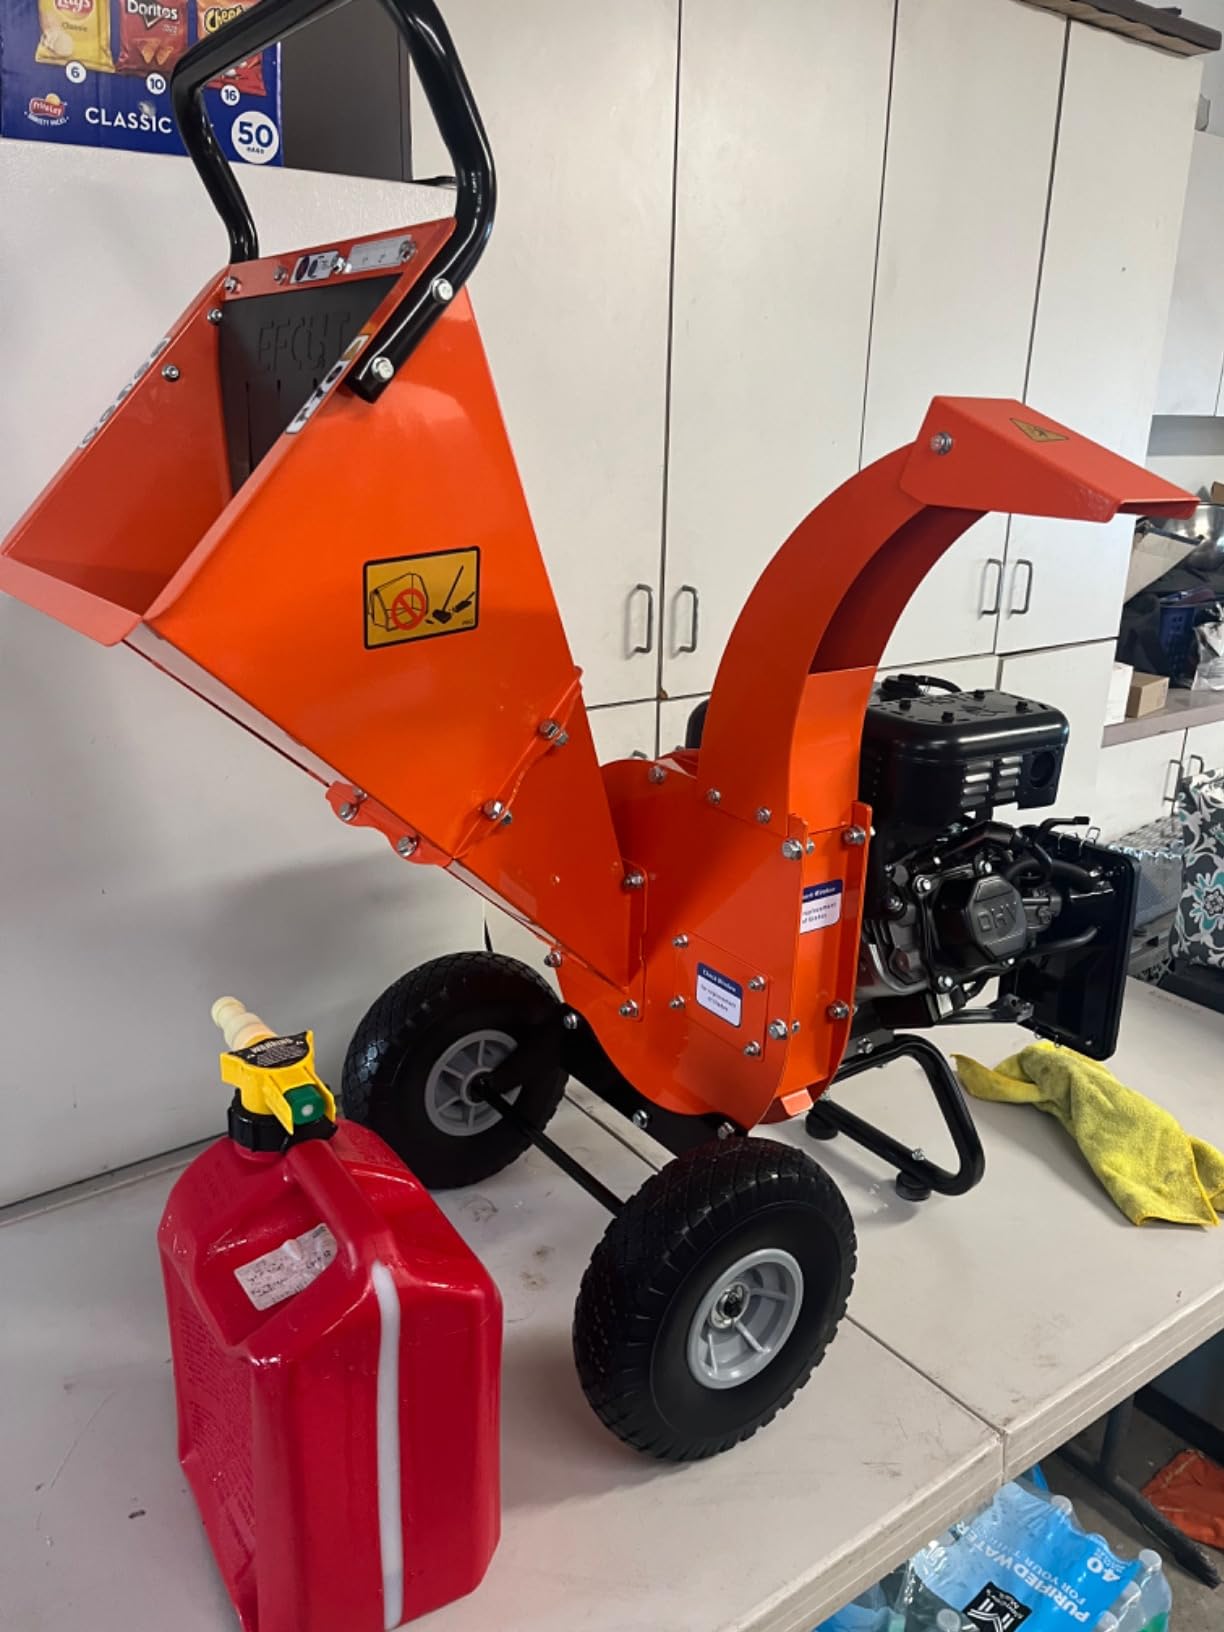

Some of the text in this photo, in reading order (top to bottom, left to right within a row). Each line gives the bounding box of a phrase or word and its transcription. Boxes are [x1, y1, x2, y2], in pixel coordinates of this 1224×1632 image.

[127, 0, 178, 20] Doritos
[71, 66, 80, 78] 6
[150, 79, 163, 90] 10
[224, 89, 237, 101] 16
[85, 107, 173, 134] CLASSIC
[238, 121, 273, 148] 50
[955, 1519, 1090, 1622] PURIFIED WATER
[1024, 1557, 1059, 1585] YOUR
[1087, 1556, 1120, 1582] 40
[1060, 1582, 1086, 1605] FOR
